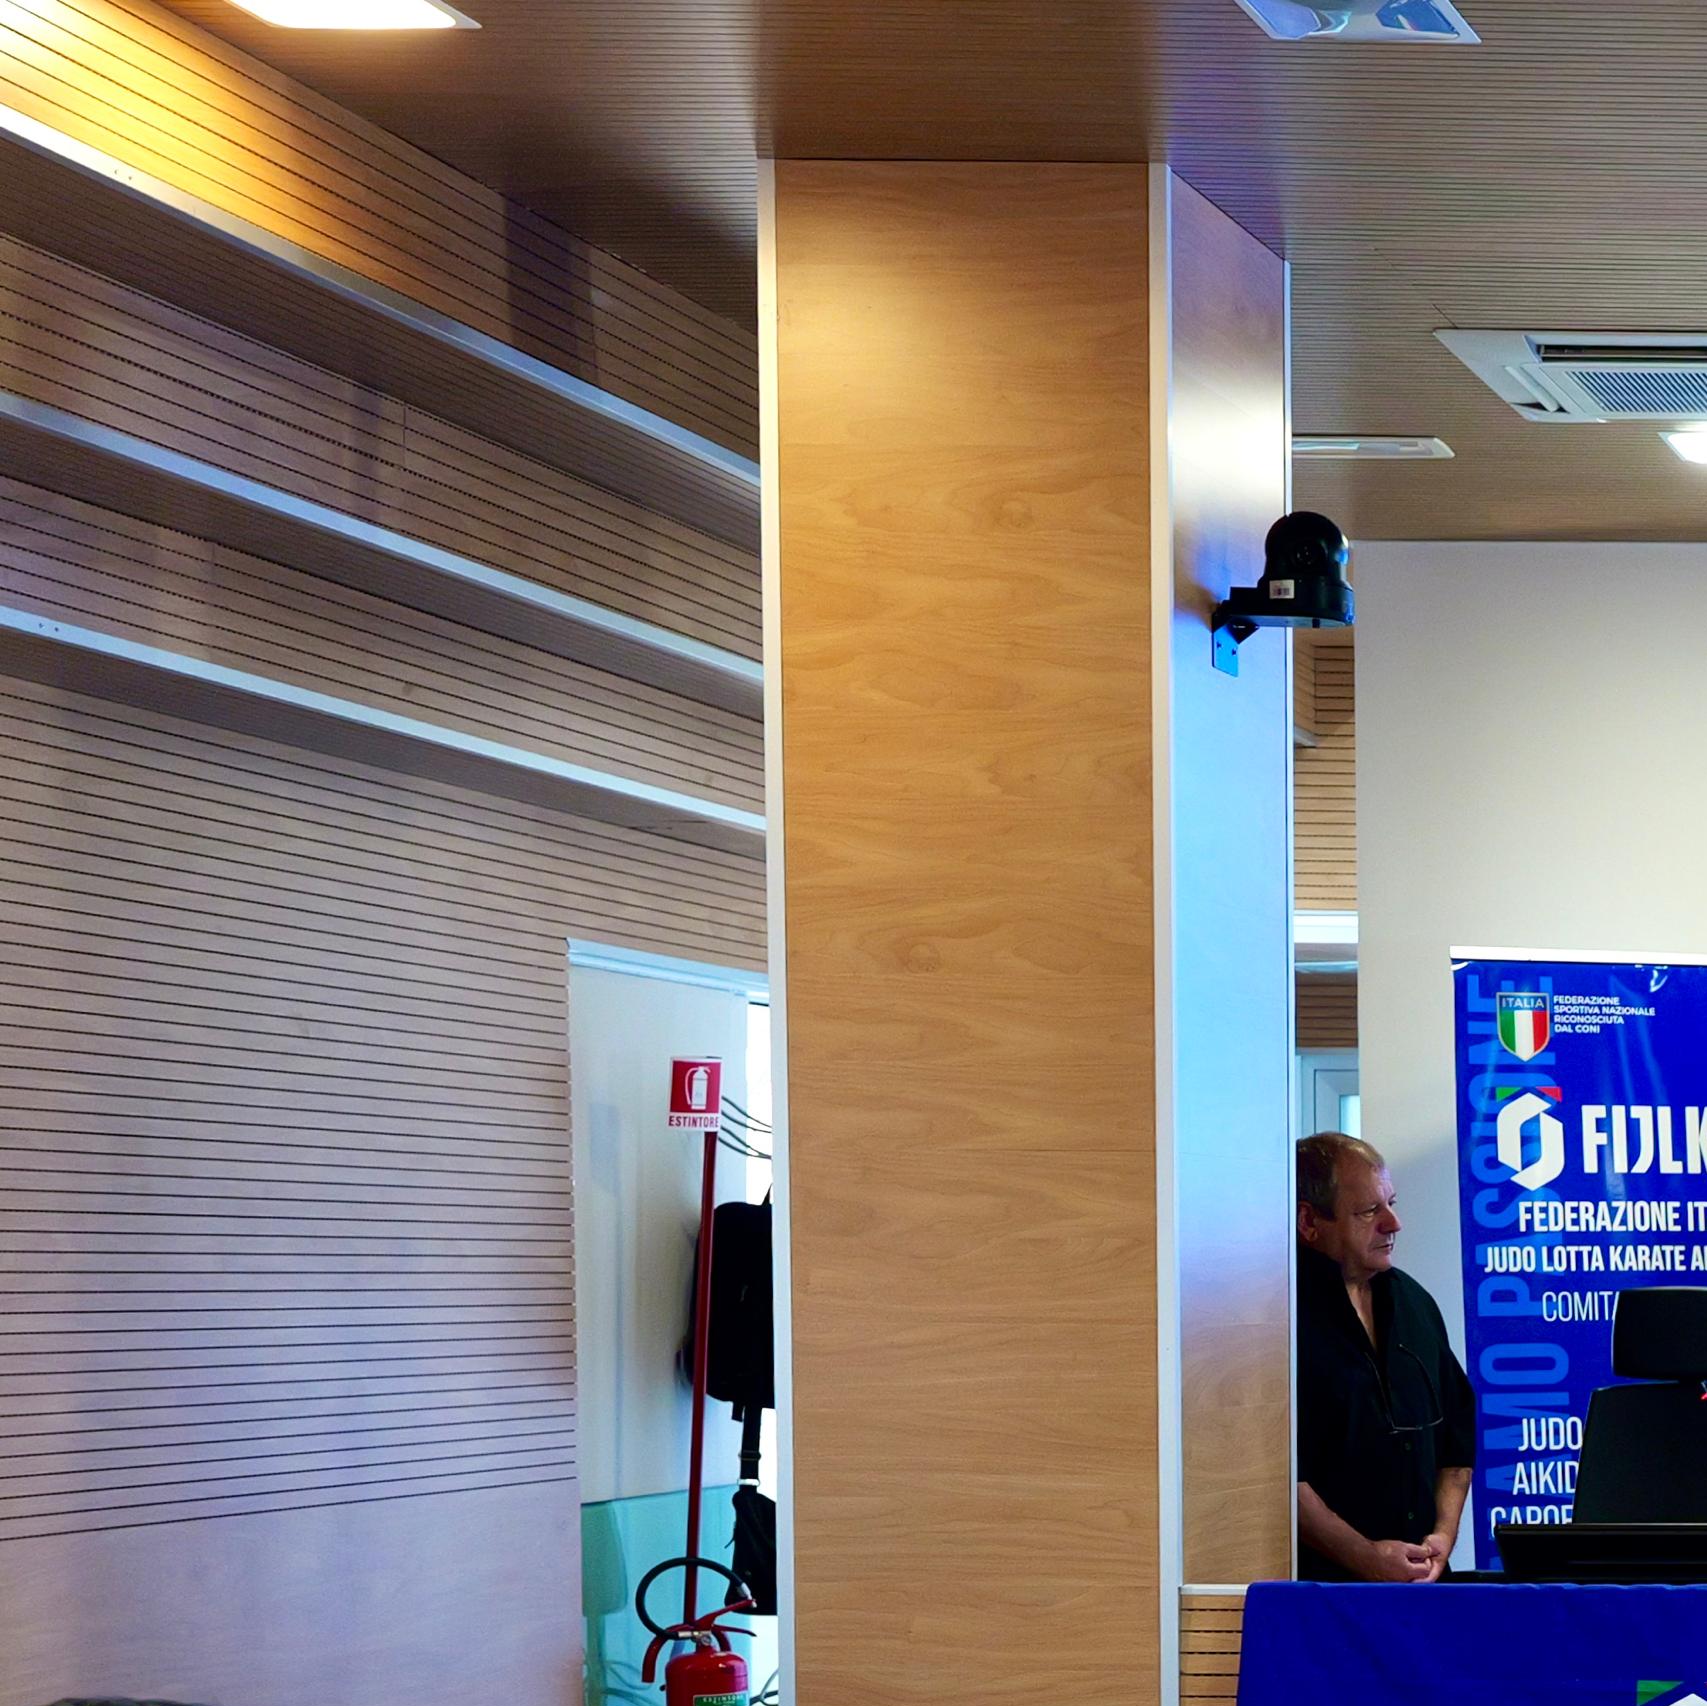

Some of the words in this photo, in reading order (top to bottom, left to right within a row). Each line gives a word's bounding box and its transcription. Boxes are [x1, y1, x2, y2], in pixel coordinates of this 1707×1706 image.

[1501, 997, 1545, 1009] ITALIA
[1553, 995, 1620, 1006] FEDERAZIONE
[1553, 1005, 1600, 1015] SPORTIVA
[1601, 1006, 1656, 1016] NAZIONALE
[1554, 1015, 1624, 1025] RICONOSCIUTA
[1554, 1024, 1573, 1034] DAL
[1575, 1024, 1600, 1034] CONI
[668, 1114, 720, 1129] ESTINTORE
[1519, 1201, 1682, 1233] FEDERAZIONE
[1484, 1246, 1537, 1274] JUDO
[1541, 1246, 1605, 1272] LOTTA
[1609, 1245, 1686, 1272] KARATE
[1518, 1416, 1583, 1451] JUDO
